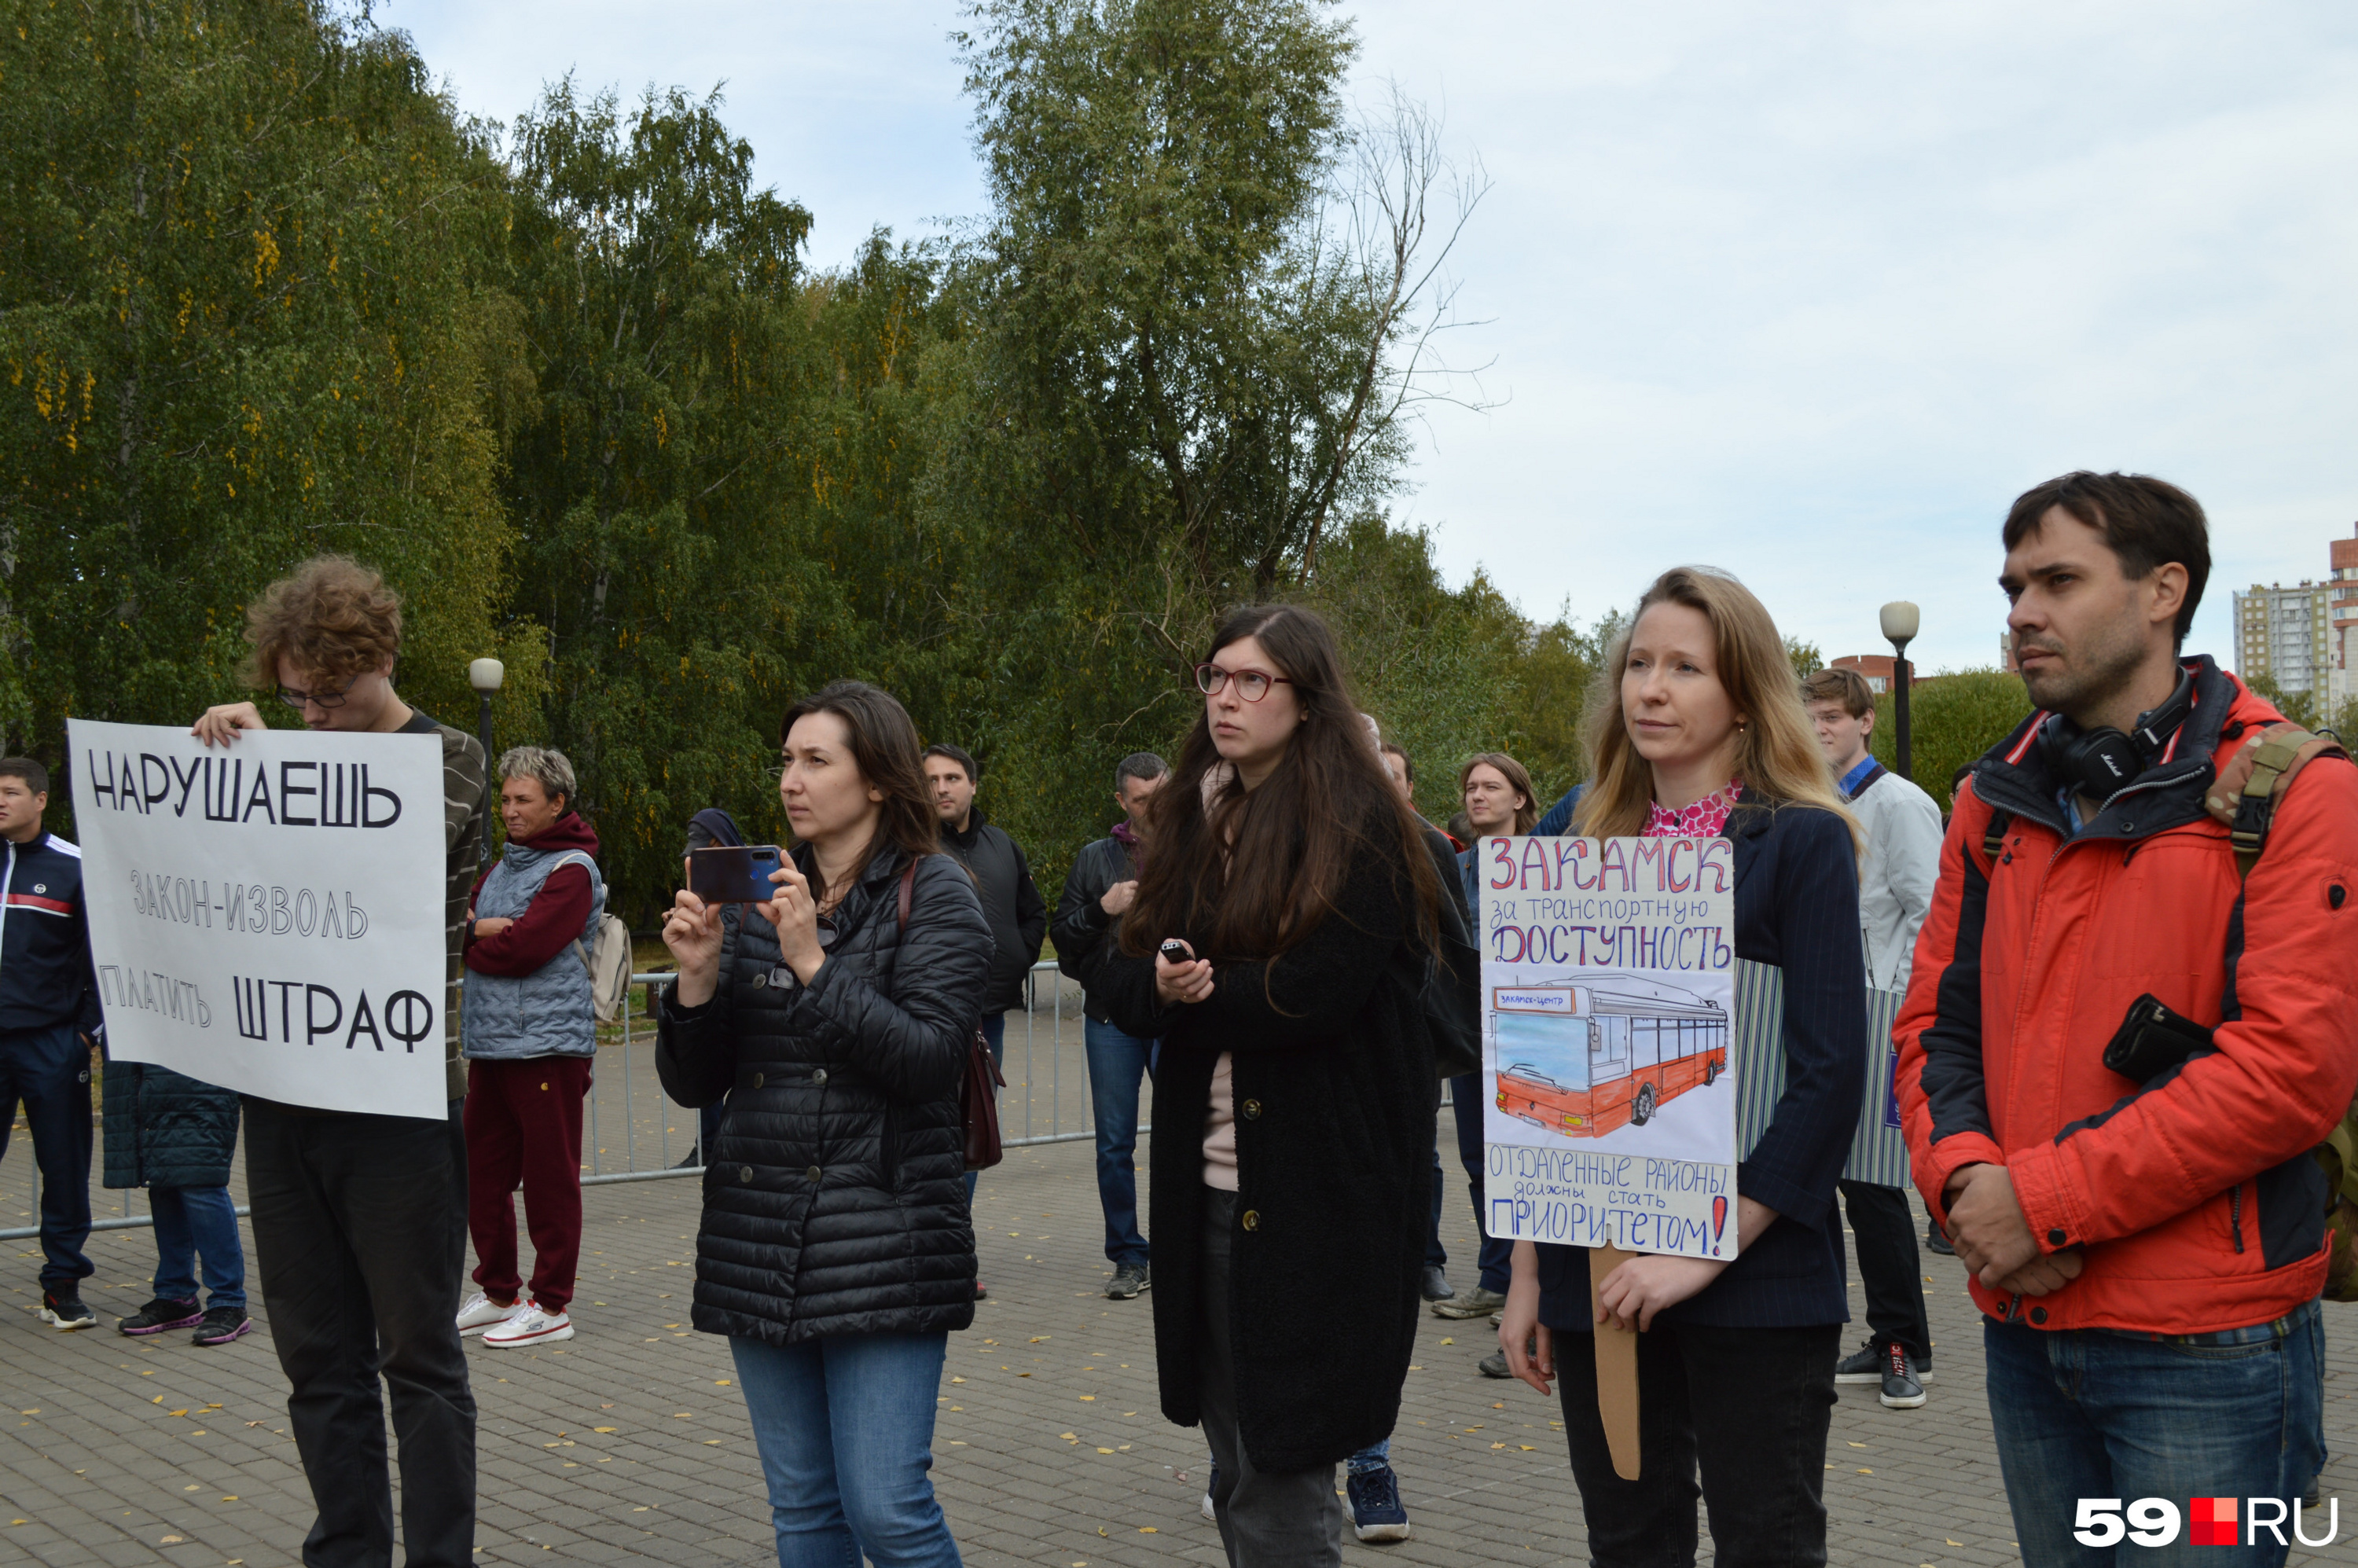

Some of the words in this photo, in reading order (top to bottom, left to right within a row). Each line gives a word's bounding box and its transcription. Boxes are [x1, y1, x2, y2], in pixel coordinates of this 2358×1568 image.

[89, 749, 402, 828] НАРУШАЕШЬ
[2100, 753, 2123, 777] Marshall
[1491, 838, 1731, 893] ЗАКАМСК
[130, 869, 369, 939] ЗАКОН-ИЗВОЛЬ
[1490, 901, 1517, 929] за
[1492, 925, 1732, 970] ДОСТУПНОСТЬ
[99, 965, 211, 1028] ПЛАТИТЬ
[233, 975, 434, 1053] ШТРАФ
[1489, 1144, 1631, 1187] ОТДАЛЕННЫЕ
[1646, 1159, 1728, 1195] РАЙОНЫ
